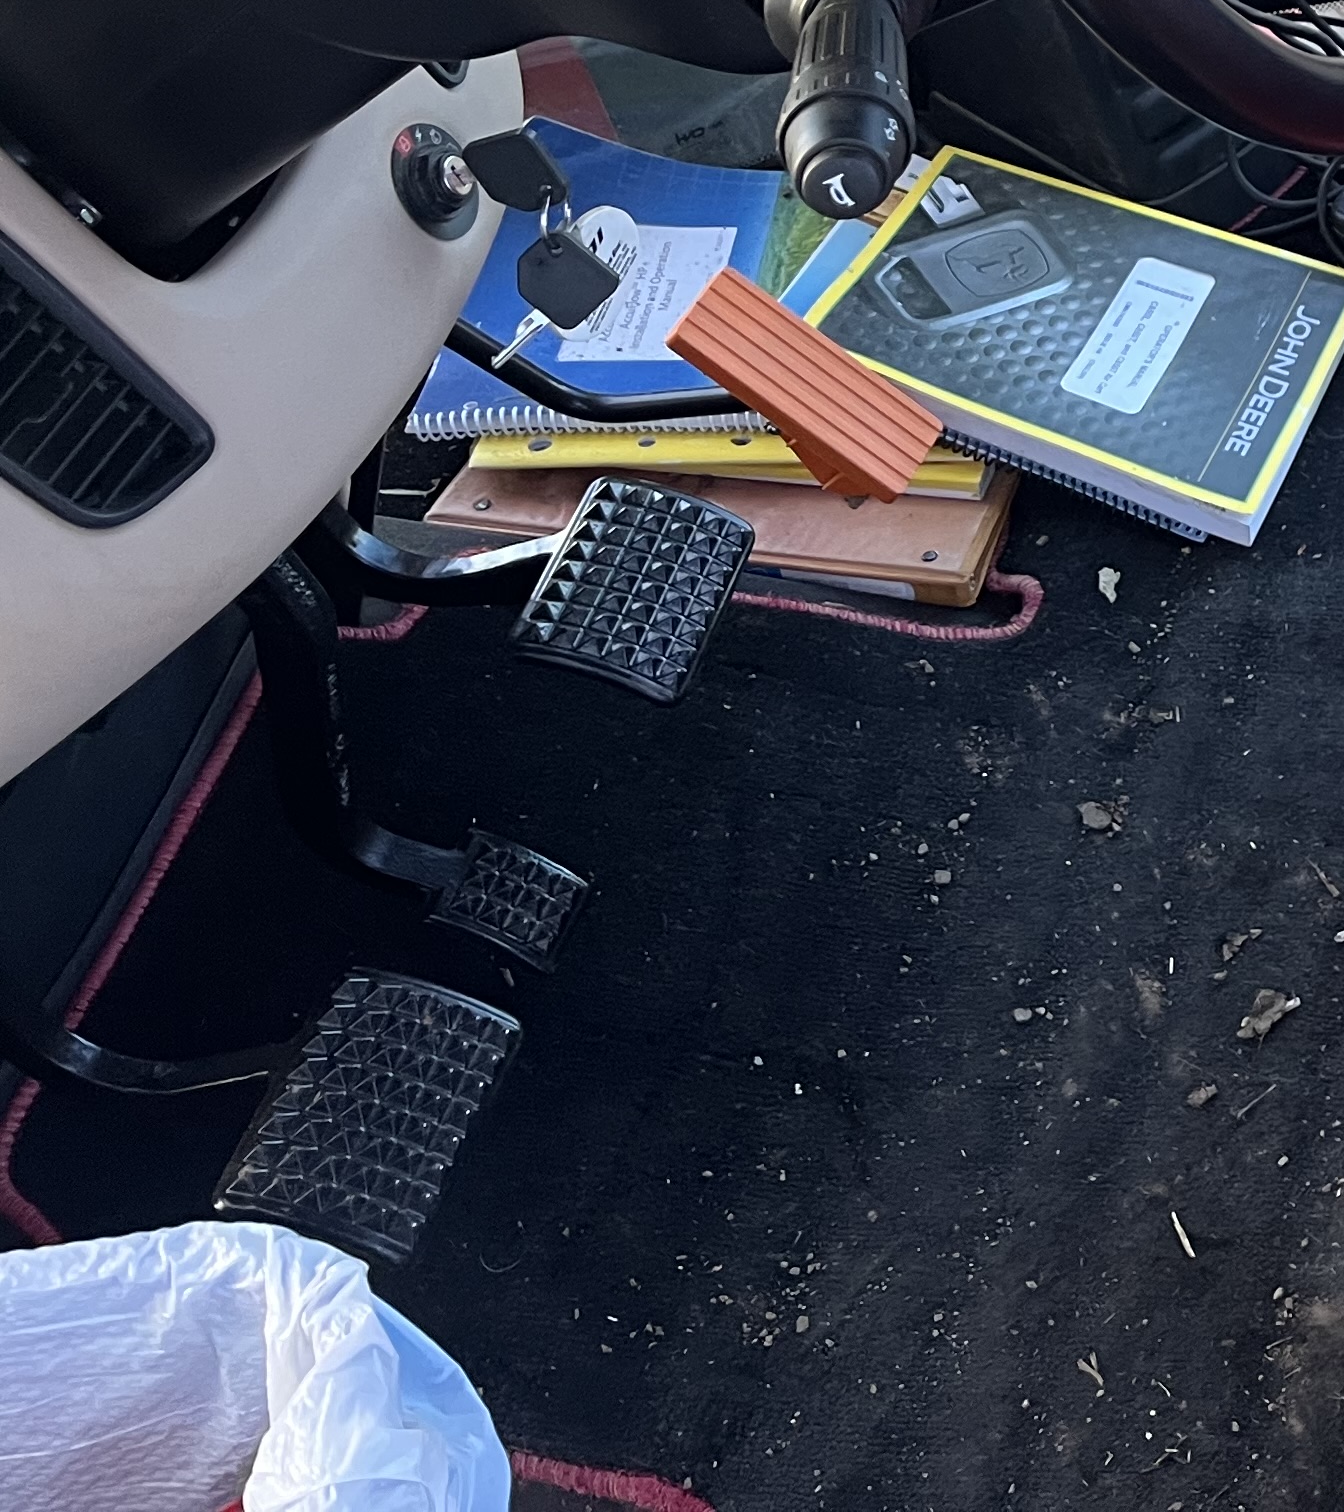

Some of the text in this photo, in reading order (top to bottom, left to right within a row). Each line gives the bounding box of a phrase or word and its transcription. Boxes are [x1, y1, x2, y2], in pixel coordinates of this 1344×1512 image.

[657, 278, 678, 312] Manual
[1224, 304, 1321, 457] JOHN DEERE
